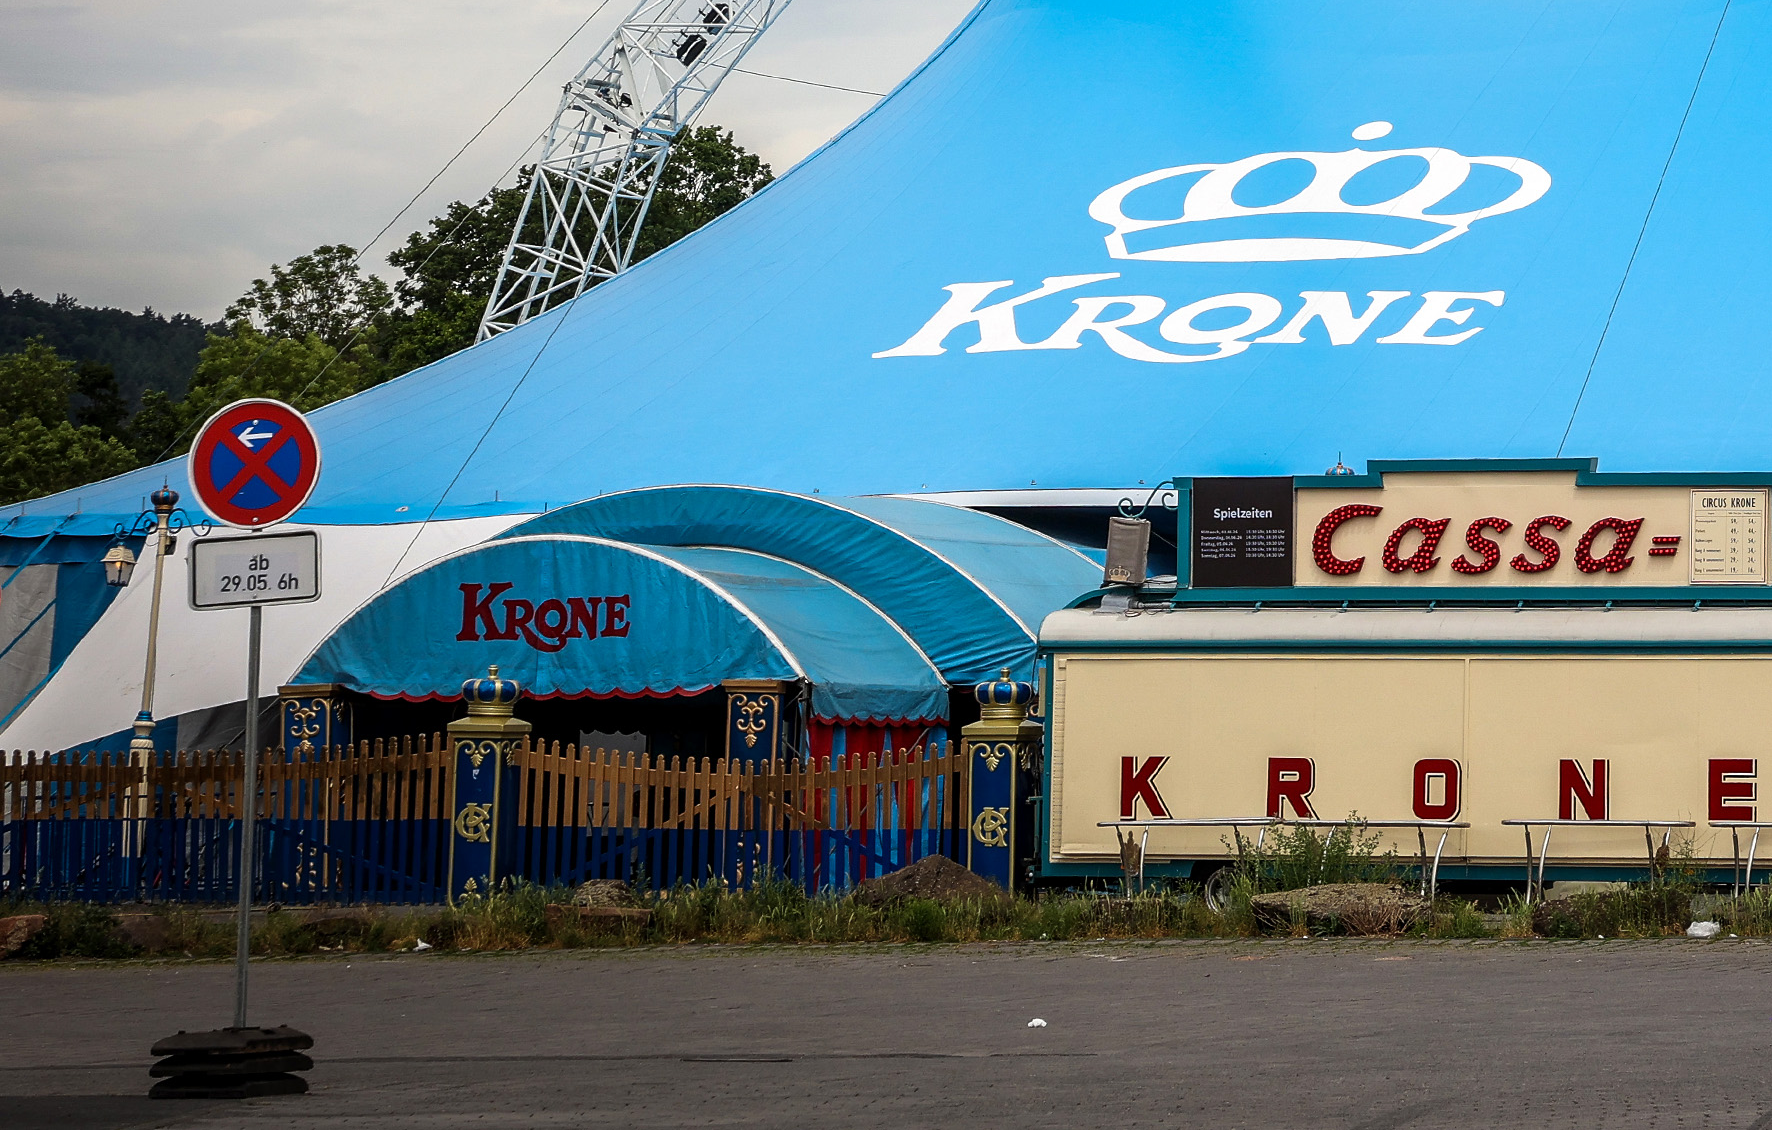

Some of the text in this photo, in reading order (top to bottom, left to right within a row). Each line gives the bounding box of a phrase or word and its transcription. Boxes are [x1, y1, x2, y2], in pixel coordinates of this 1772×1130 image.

[872, 272, 1505, 363] KRONE
[1702, 498, 1756, 508] CIRCUS KRONE
[1213, 507, 1273, 521] Spielzeiten
[249, 555, 269, 571] ab
[221, 573, 299, 592] 29.05. 6h
[456, 582, 631, 653] KRONE
